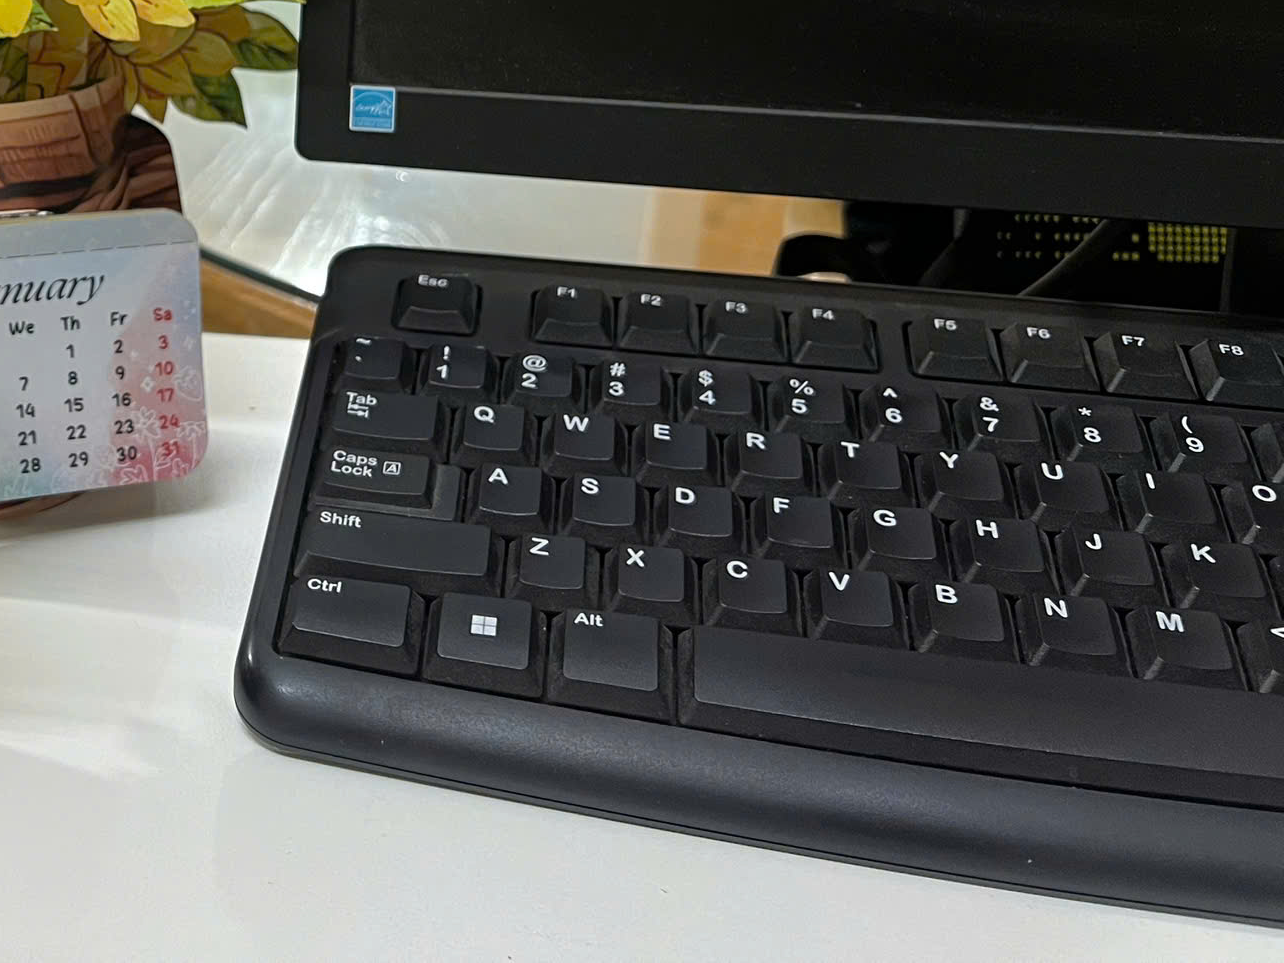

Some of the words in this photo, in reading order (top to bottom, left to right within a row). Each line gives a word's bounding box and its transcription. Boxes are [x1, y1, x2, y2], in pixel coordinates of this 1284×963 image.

[417, 274, 448, 288] Esc
[556, 286, 576, 298] F1
[640, 293, 662, 307] F2
[725, 301, 748, 314] F3
[812, 308, 835, 321] F4
[8, 320, 35, 336] We
[59, 315, 81, 331] Th
[110, 311, 128, 327] Fr
[152, 307, 173, 322] Sa
[933, 318, 957, 331] F5
[1026, 326, 1051, 339] F6
[1121, 335, 1145, 347] F7
[65, 343, 75, 359] 1
[113, 339, 124, 354] 2
[158, 334, 169, 350] 3
[442, 345, 450, 361] !
[1218, 343, 1244, 356] F8
[436, 364, 448, 379] 1
[522, 354, 547, 372] @
[609, 362, 626, 377] #
[18, 376, 29, 392] 7
[67, 370, 79, 386] 8
[115, 365, 125, 381] 9
[154, 360, 175, 377] 10
[521, 372, 537, 389] 2
[698, 369, 714, 388] $
[608, 381, 624, 397] 3
[789, 378, 815, 396] %
[15, 402, 36, 419] 14
[64, 397, 85, 413] 15
[111, 391, 132, 407] 16
[156, 387, 175, 403] 17
[346, 391, 377, 405] Tab
[698, 389, 716, 405] 4
[791, 398, 808, 414] 5
[979, 396, 1000, 412] &
[473, 405, 495, 424] Q
[563, 414, 589, 432] W
[885, 407, 903, 424] 6
[17, 429, 37, 447] 21
[65, 424, 87, 441] 22
[114, 418, 135, 435] 23
[158, 413, 181, 430] 24
[653, 423, 671, 441] E
[982, 416, 999, 433] 7
[1181, 415, 1193, 434] (
[746, 432, 766, 450] R
[1083, 427, 1102, 443] 8
[840, 441, 860, 458] T
[1185, 437, 1204, 453] 9
[19, 457, 42, 474] 28
[68, 451, 89, 468] 29
[116, 447, 137, 462] 30
[161, 441, 180, 456] 31
[333, 450, 378, 466] Caps
[939, 451, 959, 469] Y
[330, 460, 372, 477] Lock
[488, 467, 509, 485] A
[1041, 462, 1064, 480] U
[581, 477, 599, 495] S
[1145, 472, 1156, 490] I
[675, 486, 695, 504] D
[1251, 484, 1277, 502] O
[773, 497, 790, 514] F
[319, 511, 362, 528] Shift
[873, 509, 897, 527] G
[975, 519, 999, 539] H
[529, 537, 549, 556] Z
[1085, 533, 1102, 550] J
[626, 547, 645, 568] X
[1190, 543, 1216, 564] K
[726, 560, 748, 579] C
[307, 578, 342, 593] Ctrl
[828, 571, 850, 591] V
[935, 584, 958, 604] B
[1043, 597, 1068, 618] N
[573, 612, 604, 627] Alt
[1155, 610, 1185, 633] M
